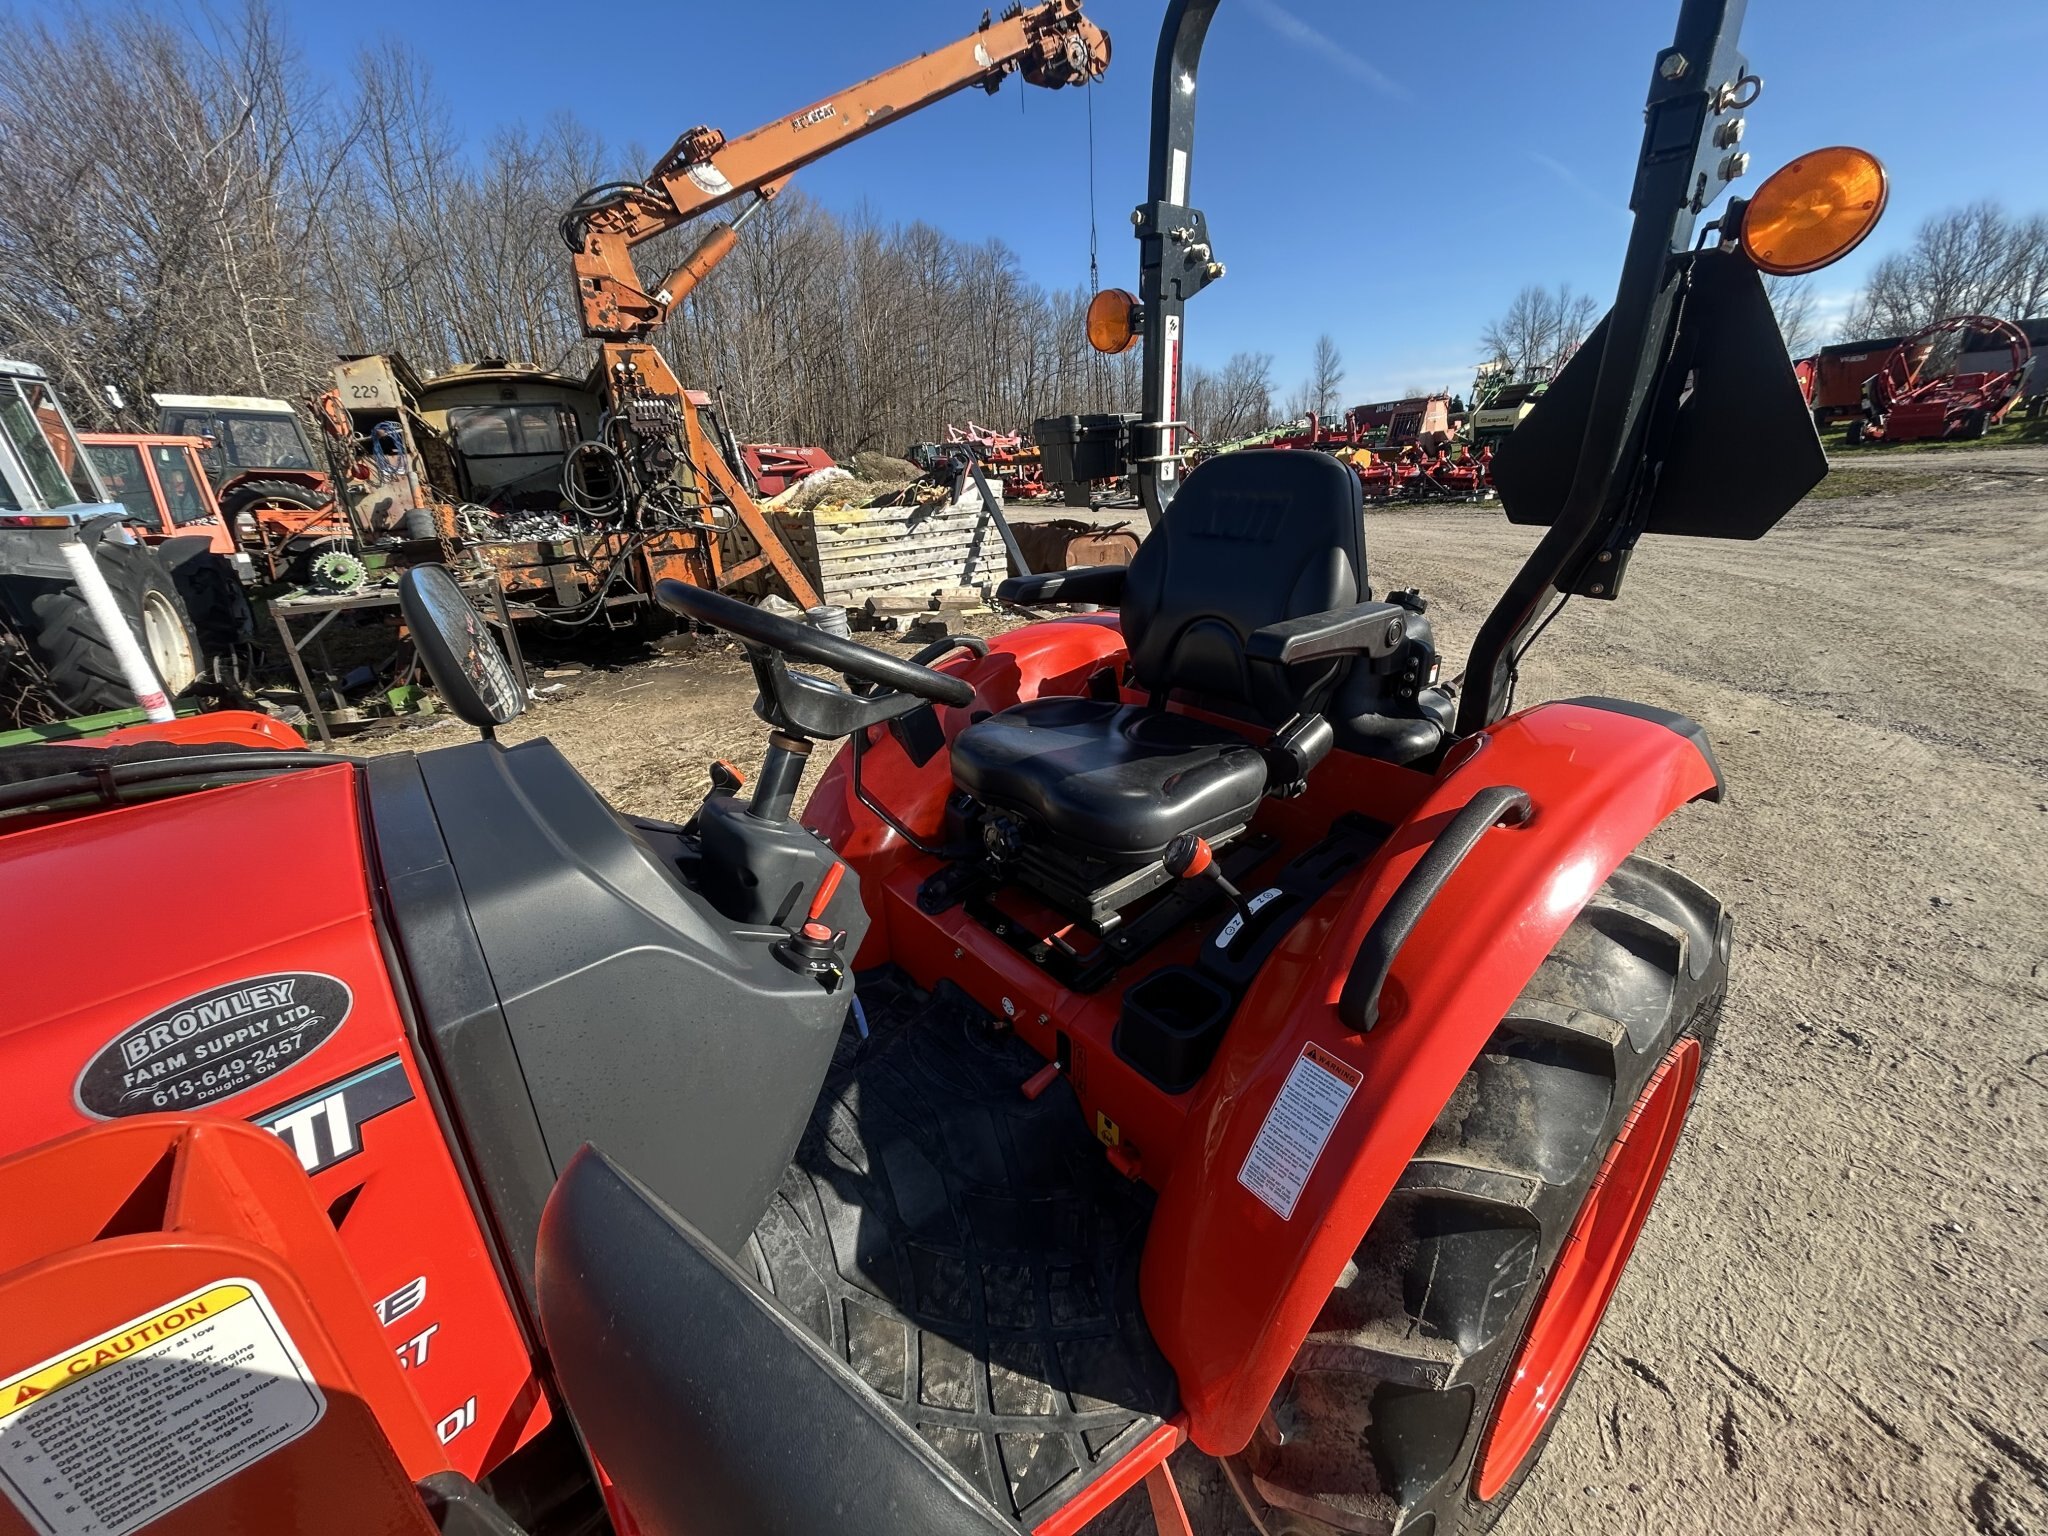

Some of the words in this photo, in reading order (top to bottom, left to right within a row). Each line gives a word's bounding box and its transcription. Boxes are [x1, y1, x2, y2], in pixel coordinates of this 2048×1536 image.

[351, 385, 379, 399] 229
[120, 978, 296, 1068] BROMLEY
[122, 1051, 188, 1089] FARM
[194, 1018, 269, 1059] SUPPLY
[275, 1004, 316, 1027] LTD.
[152, 1033, 303, 1106] 613-649-2457
[196, 1073, 251, 1100] Douglas
[255, 1060, 277, 1074] ON
[1318, 1055, 1355, 1083] WARNING
[16, 1400, 58, 1425] Move
[60, 1384, 90, 1403] and
[92, 1369, 123, 1388] turn
[125, 1344, 172, 1371] tractor
[174, 1336, 189, 1348] at
[191, 1323, 215, 1339] low
[66, 1300, 208, 1377] CAUTION
[84, 1365, 149, 1402] (10km/h)
[10, 1437, 27, 1449] 2.
[30, 1413, 72, 1440] Carry
[74, 1388, 122, 1416] loader
[124, 1370, 160, 1392] arms
[162, 1362, 176, 1374] at
[190, 1344, 214, 1358] low
[36, 1411, 100, 1448] position
[102, 1386, 150, 1414] during
[151, 1352, 217, 1388] transport.
[41, 1426, 88, 1454] Lower
[90, 1402, 137, 1429] loader
[180, 1364, 210, 1384] stop
[211, 1342, 255, 1368] engine
[42, 1474, 57, 1485] 4.
[59, 1460, 82, 1476] Do
[84, 1446, 109, 1462] not
[110, 1424, 151, 1448] stand
[152, 1414, 168, 1426] or
[170, 1396, 203, 1417] work
[204, 1376, 242, 1399] under
[48, 1442, 78, 1461] and
[80, 1424, 112, 1444] lock
[114, 1398, 163, 1426] brakes
[164, 1375, 208, 1401] before
[208, 1351, 255, 1378] leaving
[72, 1470, 103, 1490] Add
[100, 1416, 202, 1473] recommended
[200, 1396, 238, 1420] wheel
[239, 1374, 280, 1400] ballast
[132, 1407, 166, 1428] seat.
[66, 1454, 114, 1483] raised
[114, 1428, 164, 1456] loader.
[78, 1484, 94, 1497] or
[96, 1466, 126, 1486] rear
[128, 1440, 176, 1469] weight
[176, 1428, 196, 1443] for
[197, 1398, 254, 1432] stability.
[82, 1480, 122, 1504] Move
[130, 1448, 180, 1477] wheels
[188, 1435, 203, 1446] to
[211, 1406, 254, 1433] widest
[85, 1452, 189, 1510] recommended
[186, 1424, 240, 1456] settings
[238, 1416, 254, 1427] to
[93, 1480, 155, 1517] increase
[156, 1447, 218, 1482] stability.
[103, 1497, 158, 1530] dations
[160, 1487, 175, 1498] in
[172, 1446, 247, 1490] instruction
[244, 1420, 294, 1450] manual.
[80, 1522, 97, 1534] 7.
[96, 1488, 158, 1524] Observe
[158, 1464, 200, 1490] safety
